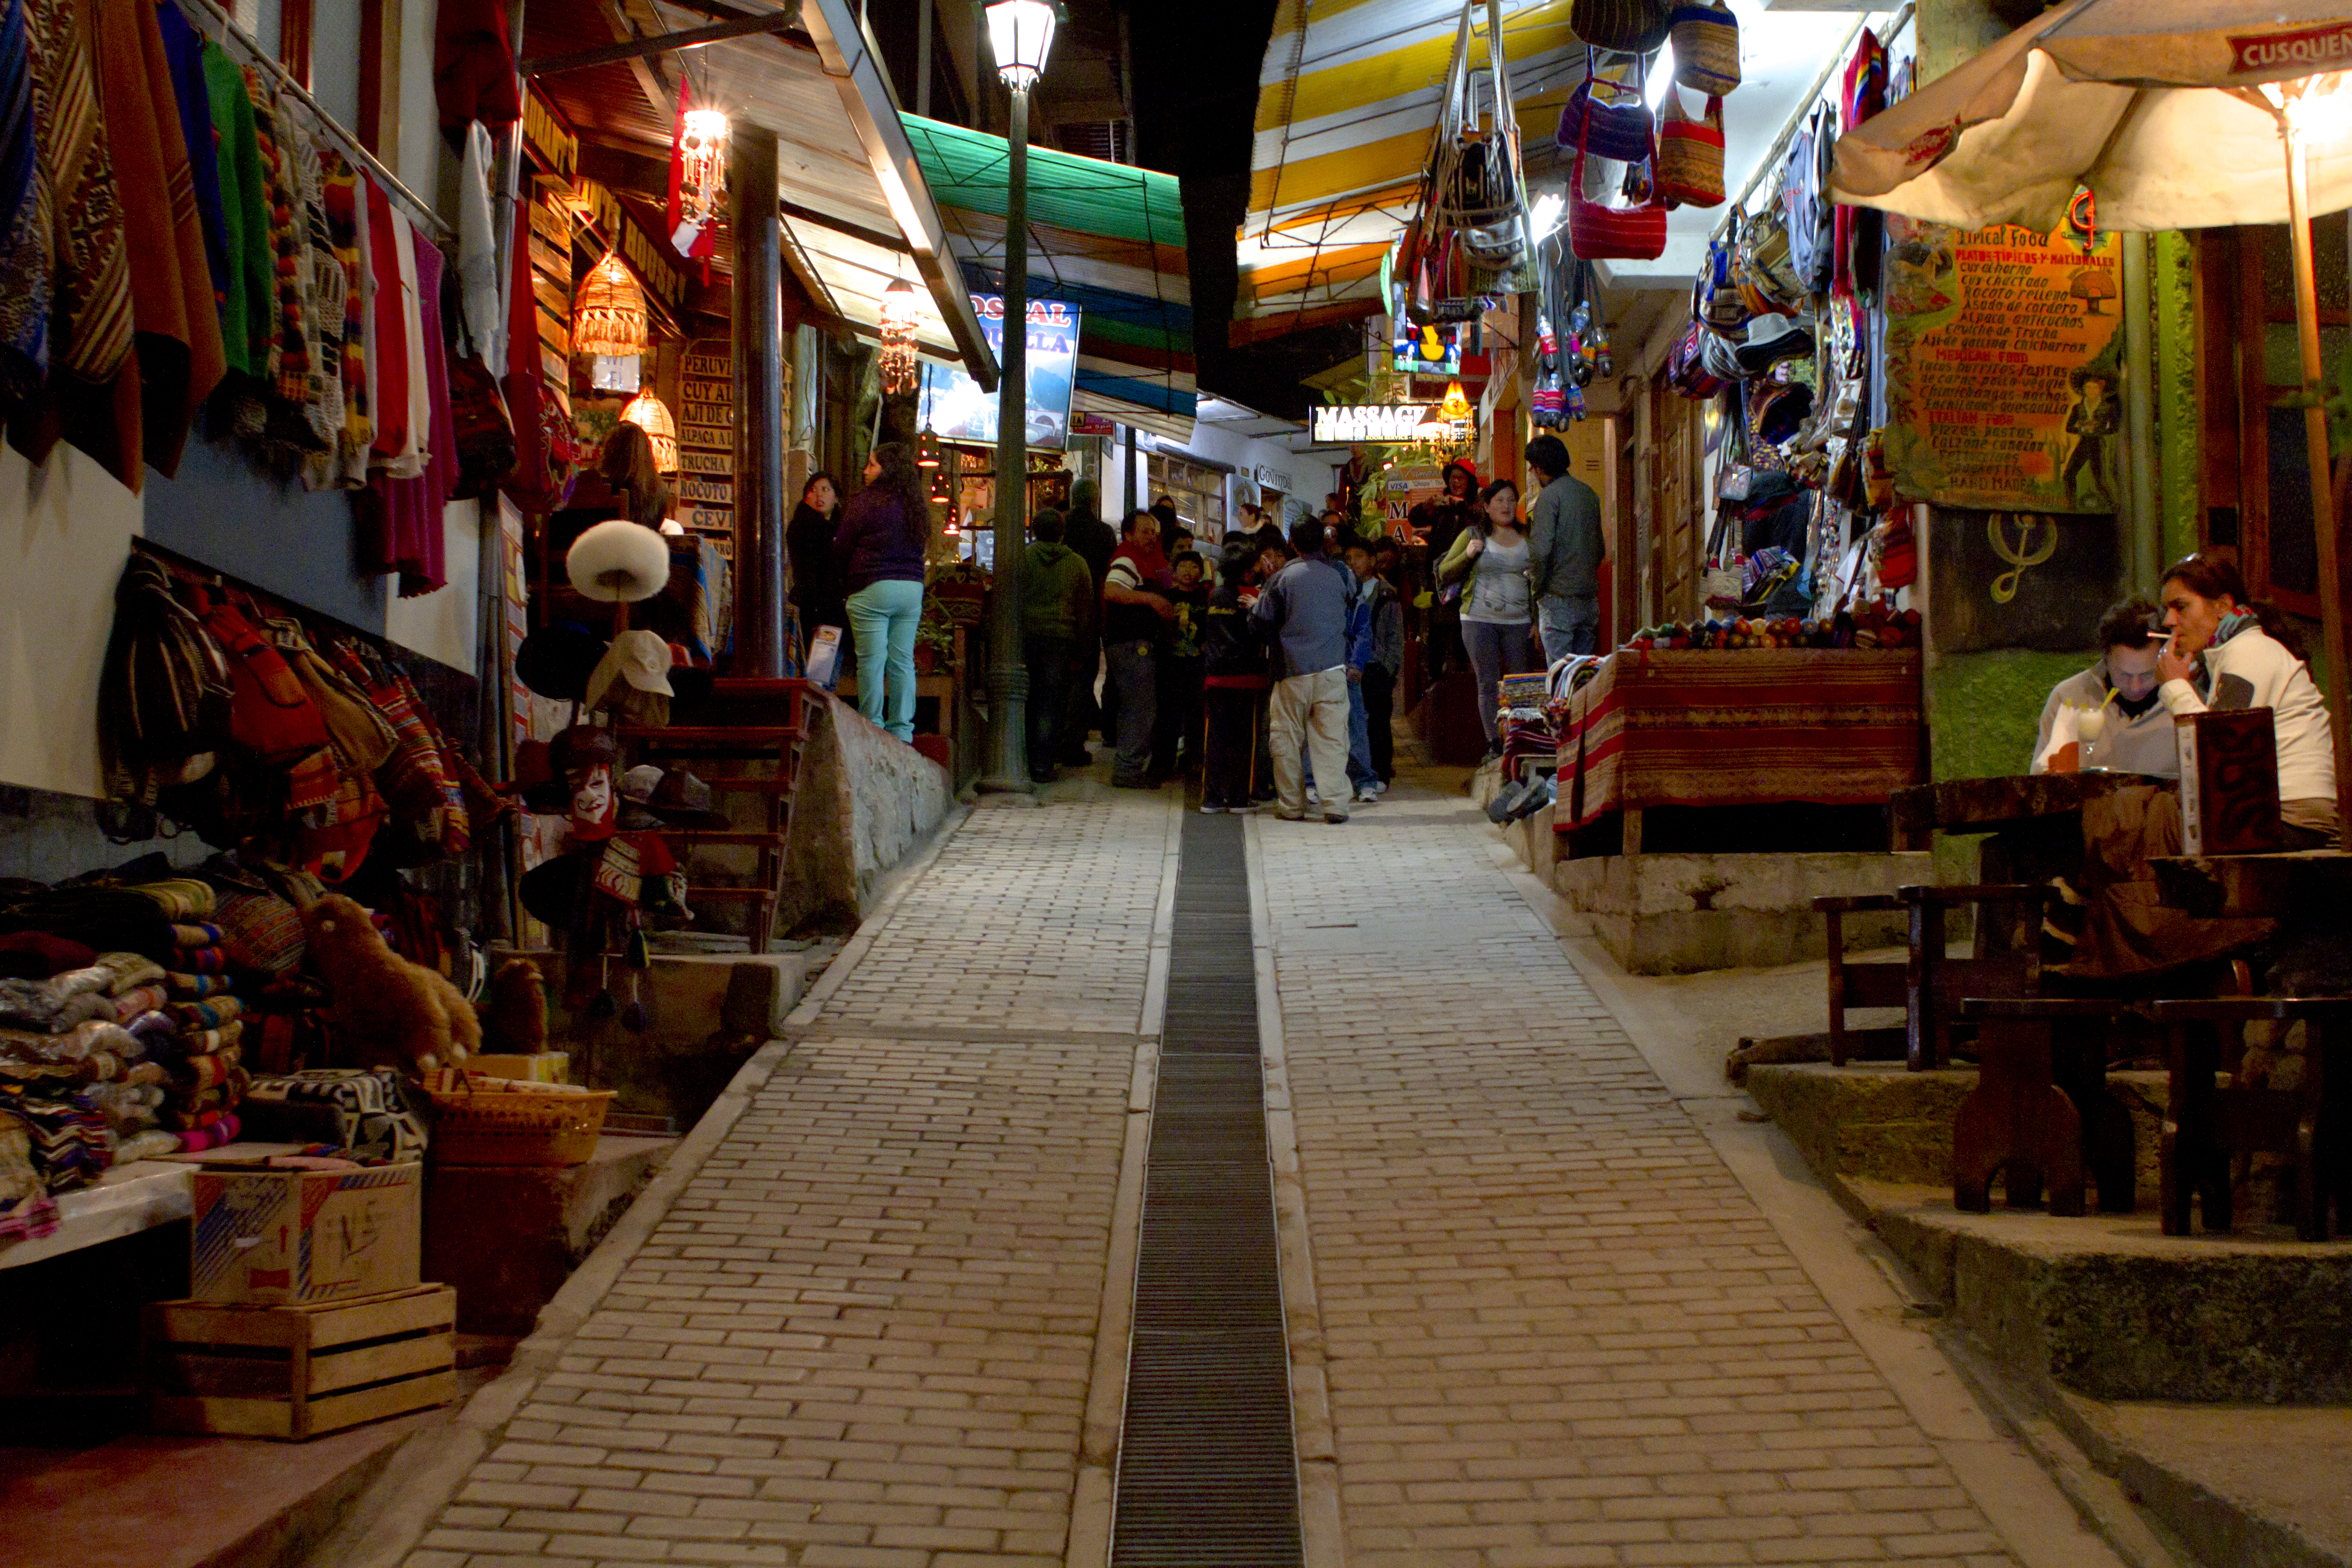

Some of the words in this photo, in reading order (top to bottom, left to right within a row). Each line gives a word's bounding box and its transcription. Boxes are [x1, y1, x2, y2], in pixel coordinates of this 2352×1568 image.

[2010, 227, 2049, 247] Food
[970, 294, 1072, 328] OSAL
[1964, 299, 2003, 311] Asado
[2007, 300, 2022, 312] de
[2026, 302, 2078, 314] cordero
[684, 382, 711, 401] CUY
[707, 406, 722, 423] DE
[681, 455, 726, 471] TRUCHA
[681, 478, 727, 500] ROCOTO
